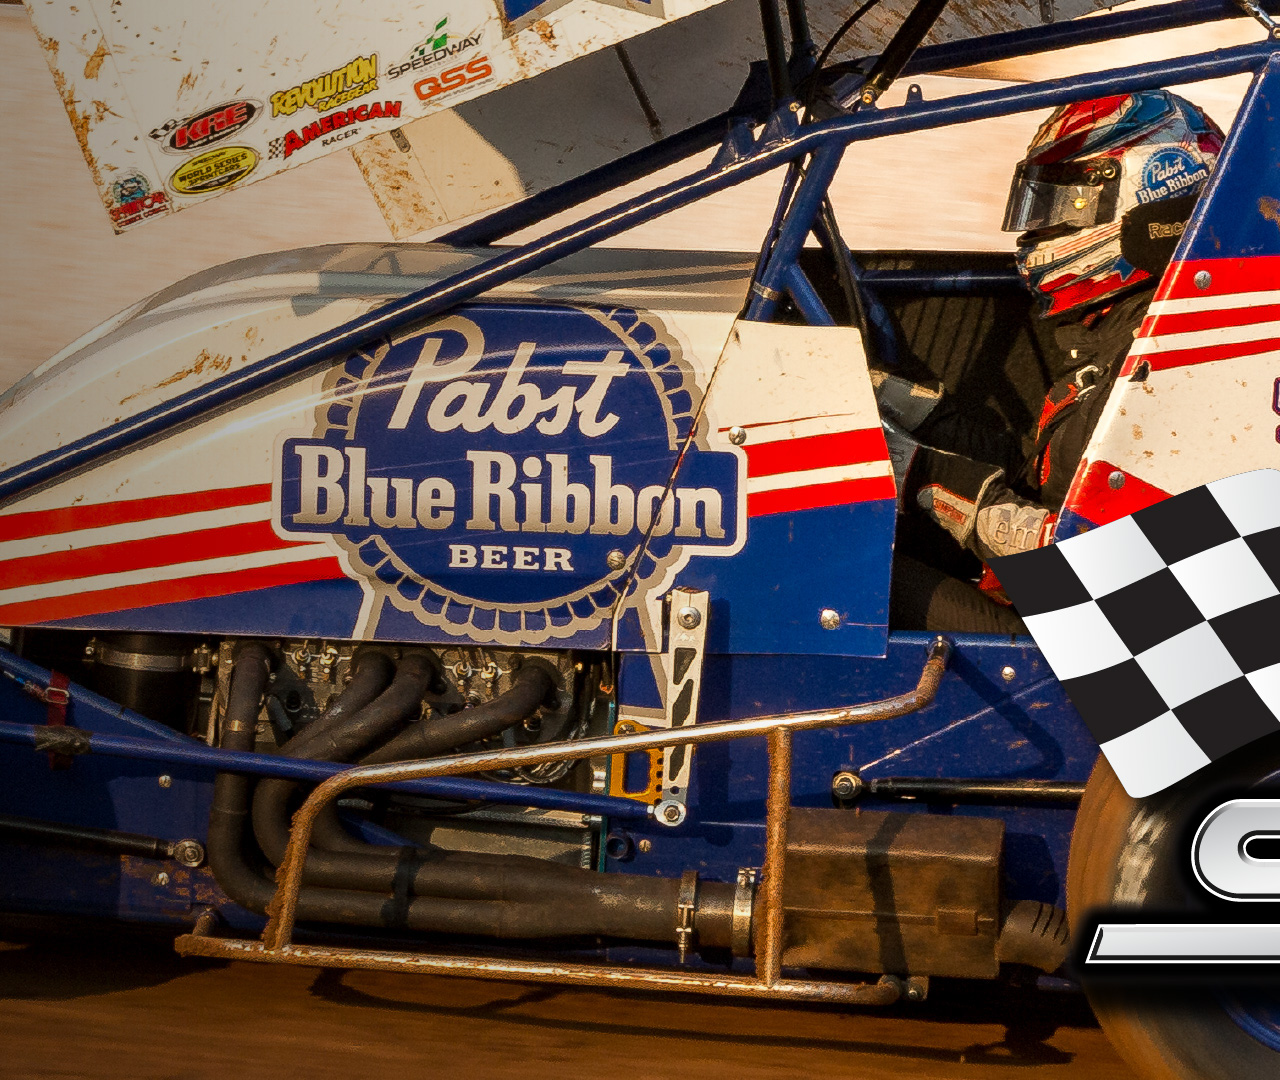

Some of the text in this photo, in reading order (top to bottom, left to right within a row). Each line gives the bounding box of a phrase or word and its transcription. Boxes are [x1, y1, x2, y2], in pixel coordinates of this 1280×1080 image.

[387, 33, 482, 80] SPEEDWAY
[414, 56, 492, 101] QSS
[270, 53, 378, 118] REVOLUTION
[318, 79, 380, 113] RACEGEAR
[283, 101, 402, 160] AMERICAN
[321, 128, 359, 147] RACER
[1137, 187, 1169, 204] Blue
[1166, 168, 1209, 193] Ribbon
[1148, 156, 1186, 184] Pabst
[388, 314, 631, 438] Pabst
[293, 444, 726, 539] Blue Ribbon
[448, 544, 575, 571] BEER
